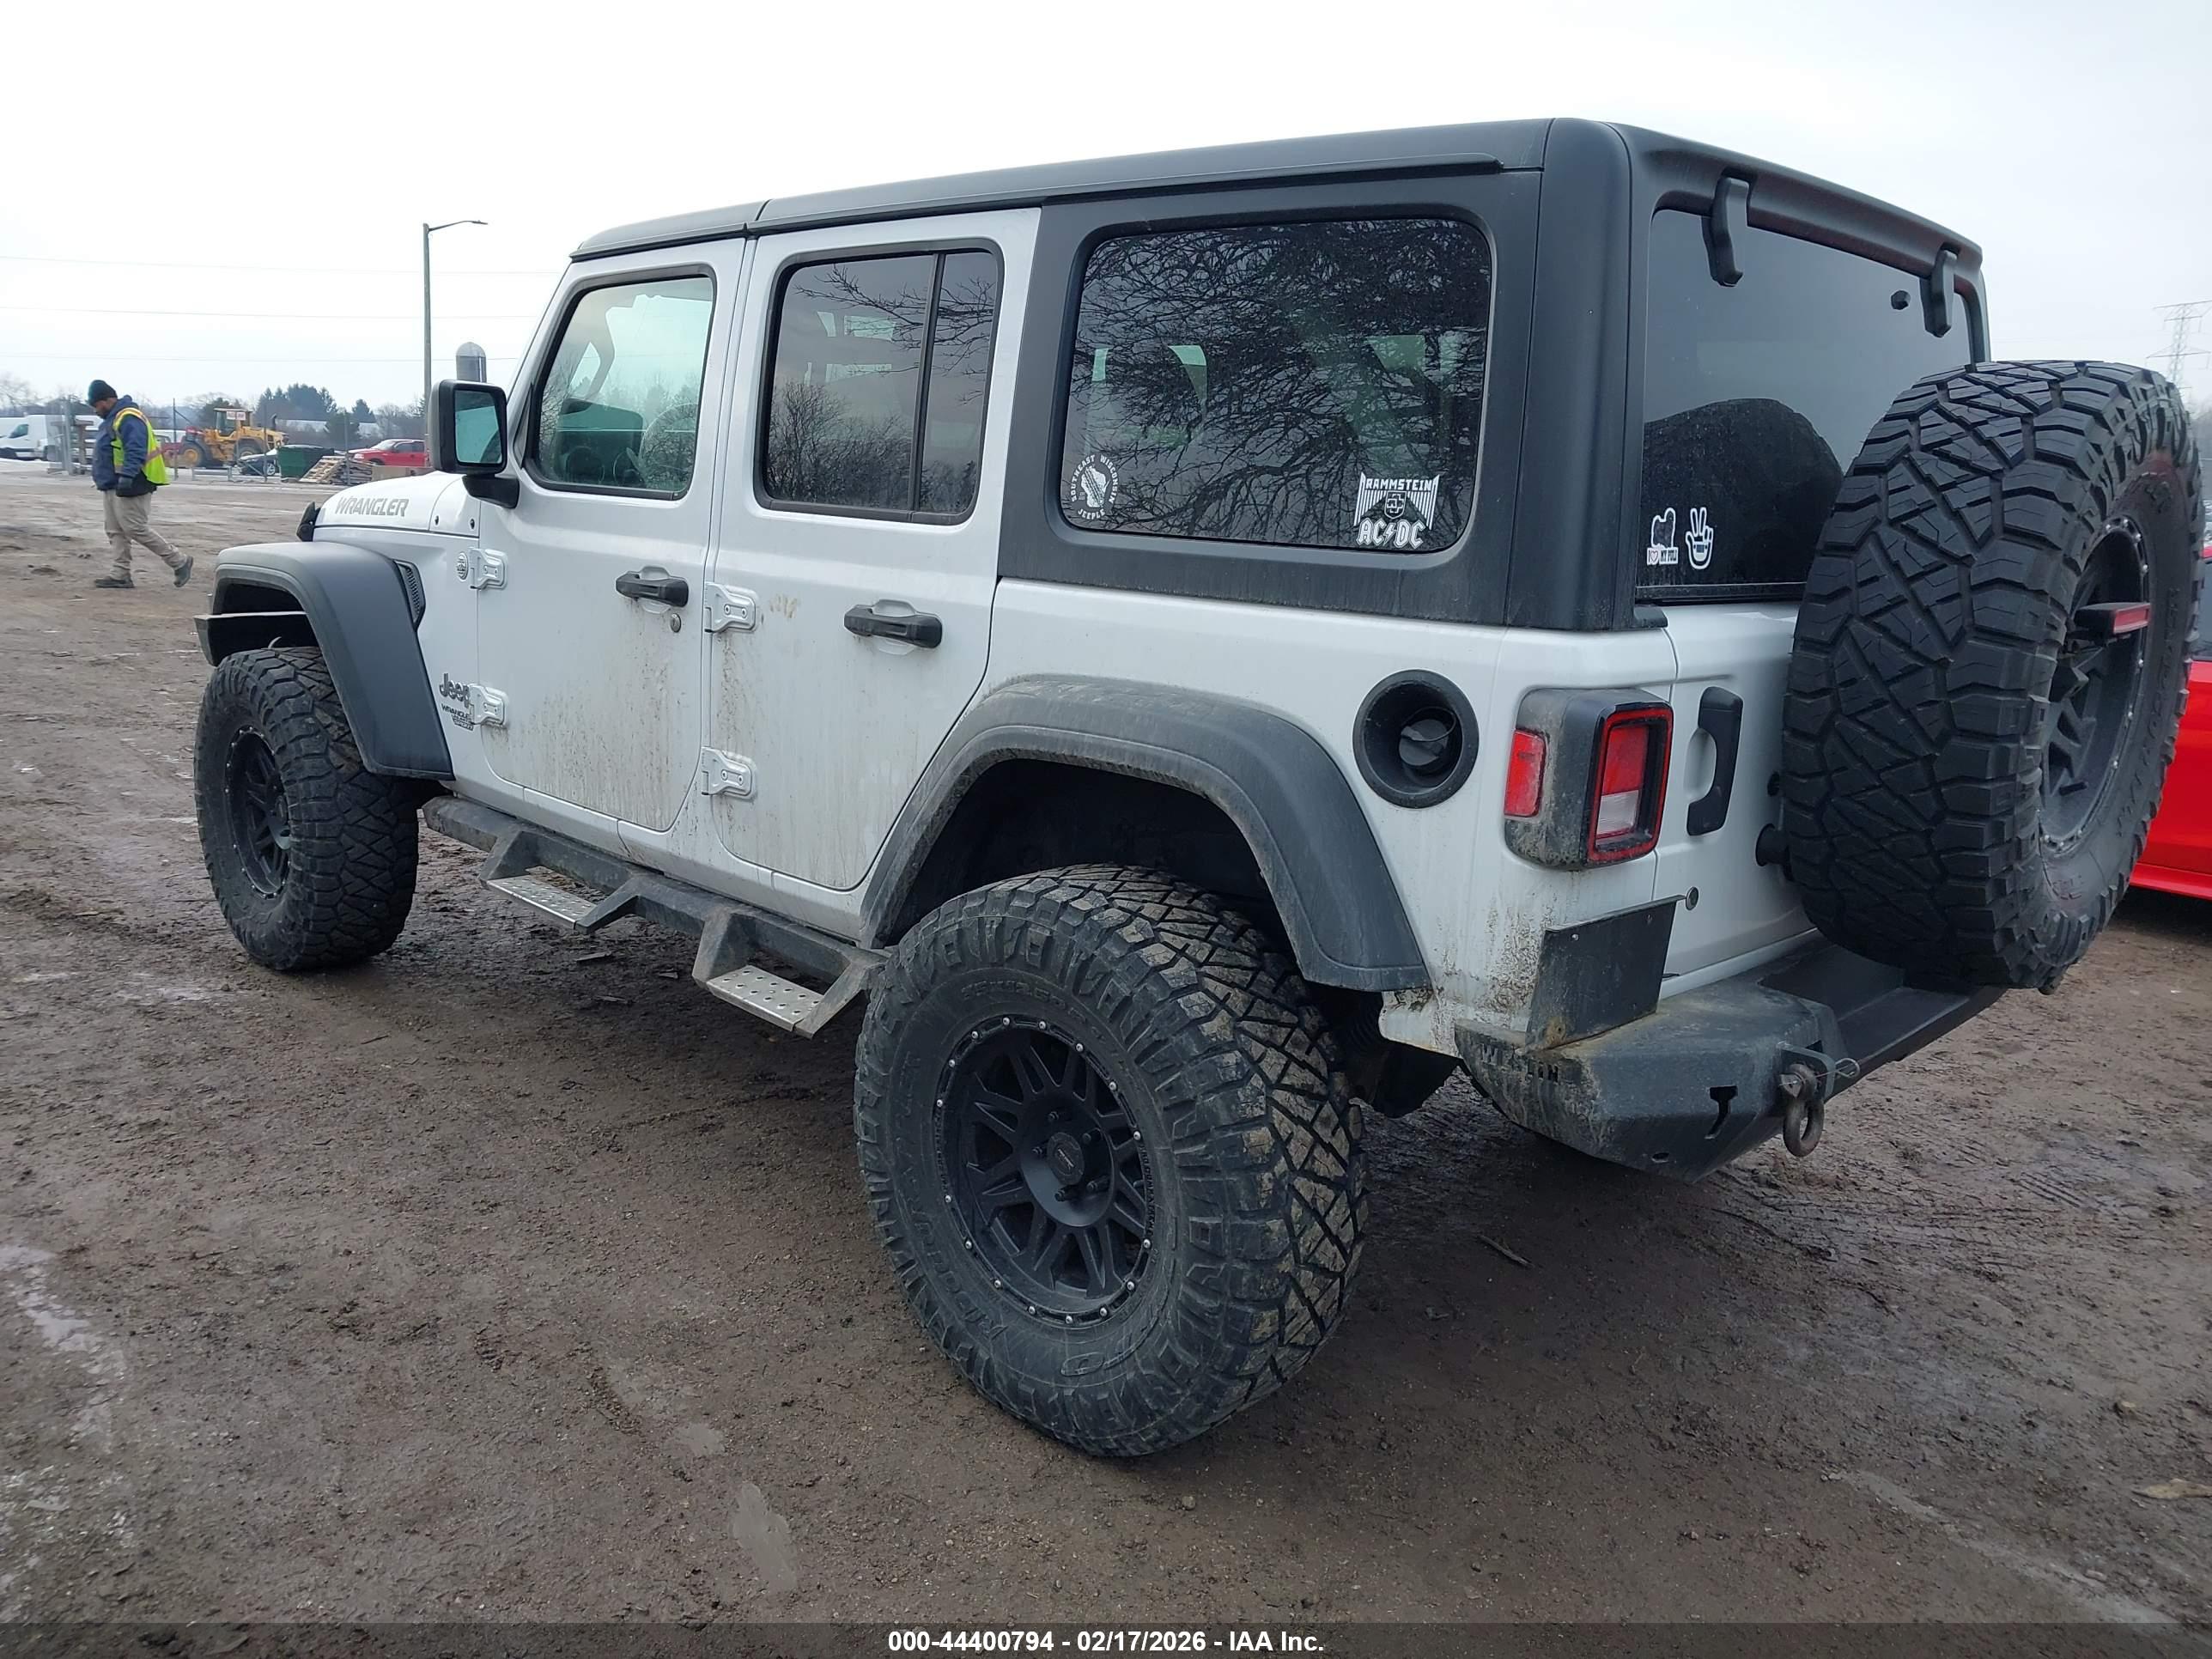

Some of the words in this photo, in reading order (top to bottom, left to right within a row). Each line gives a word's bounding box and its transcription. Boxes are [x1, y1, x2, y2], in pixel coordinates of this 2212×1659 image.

[1071, 454, 1096, 502] SOUTHEAST
[1100, 454, 1118, 503] WISCONSIN
[1365, 477, 1432, 491] RAMMSTEIN
[335, 495, 410, 517] WRANGLER
[1078, 508, 1106, 520] JEEPLE
[439, 672, 471, 709] Jeep
